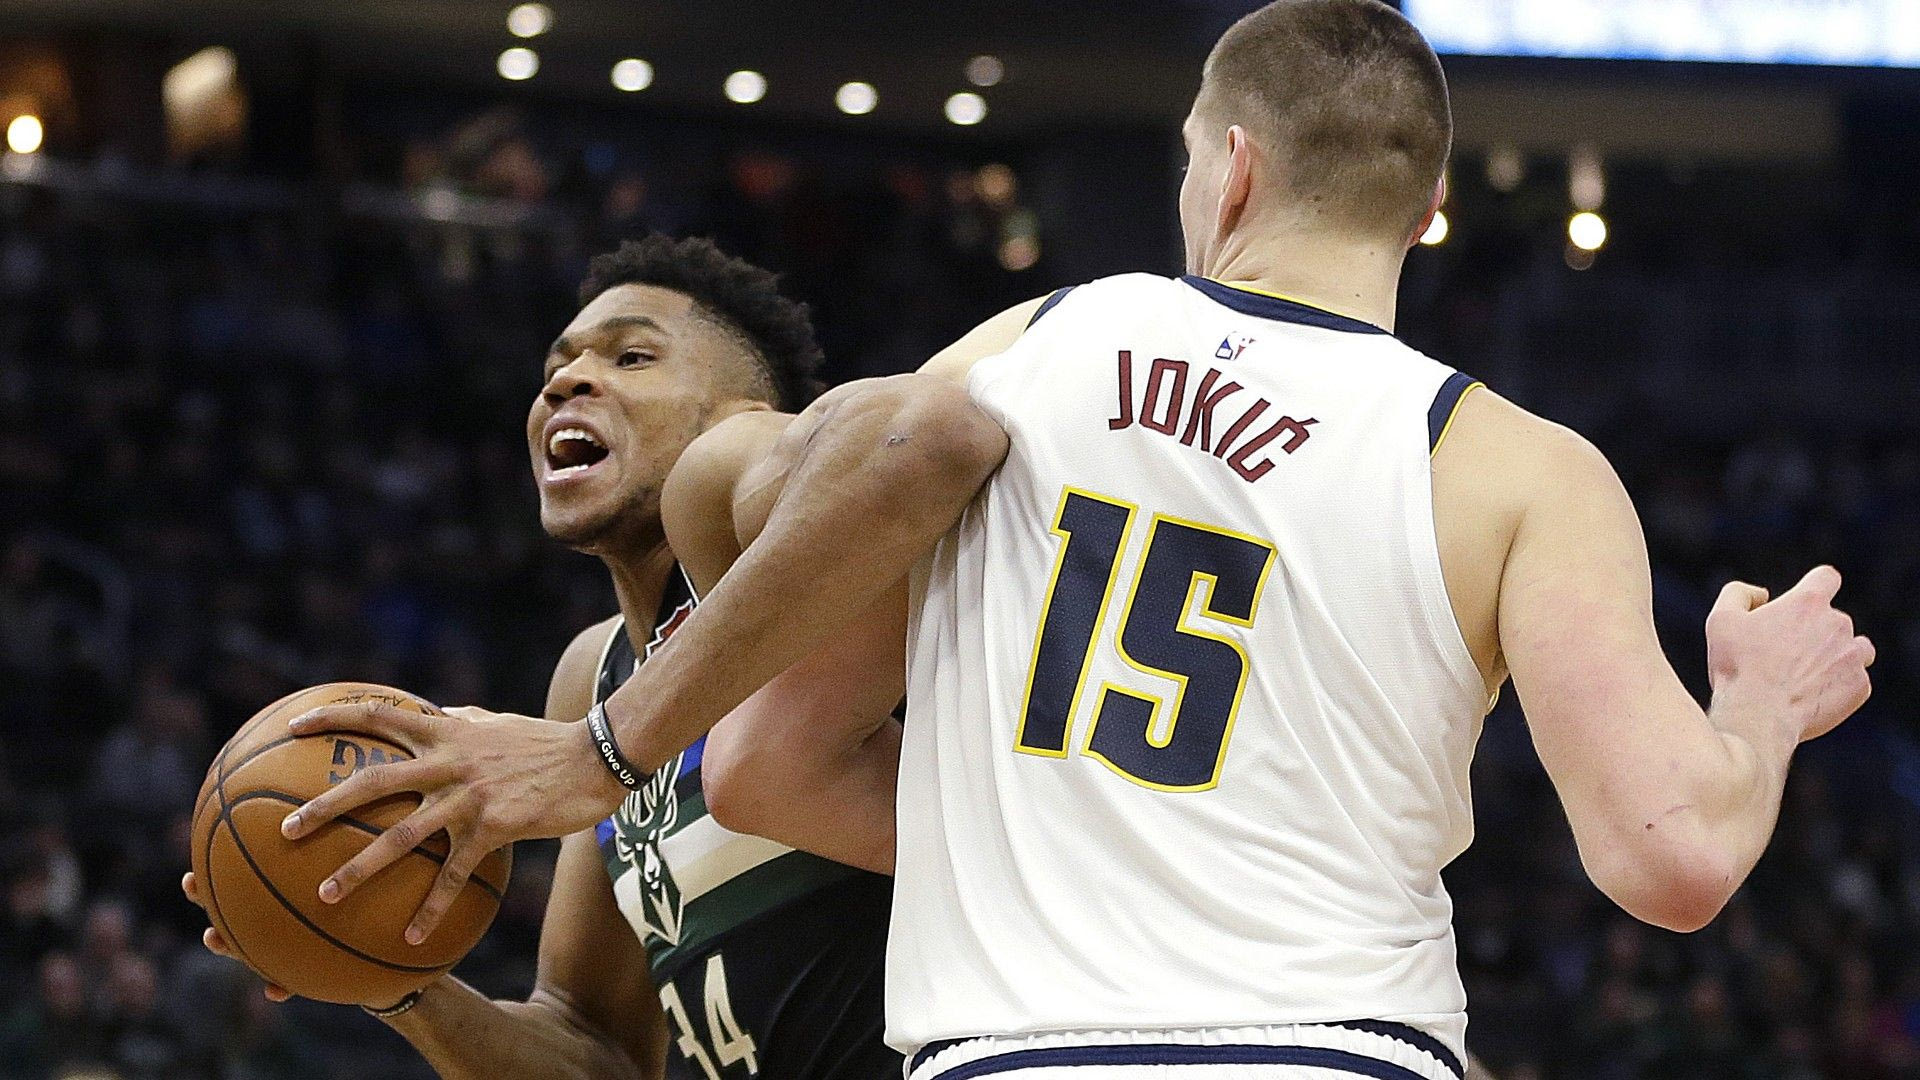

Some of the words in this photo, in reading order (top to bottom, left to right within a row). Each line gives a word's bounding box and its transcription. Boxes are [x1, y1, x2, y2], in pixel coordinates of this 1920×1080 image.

[1109, 350, 1320, 483] JOKIĆ
[1013, 484, 1278, 793] 15
[590, 710, 606, 741] Never
[601, 741, 620, 771] Give
[619, 769, 635, 785] Up
[659, 954, 758, 1080] 34
